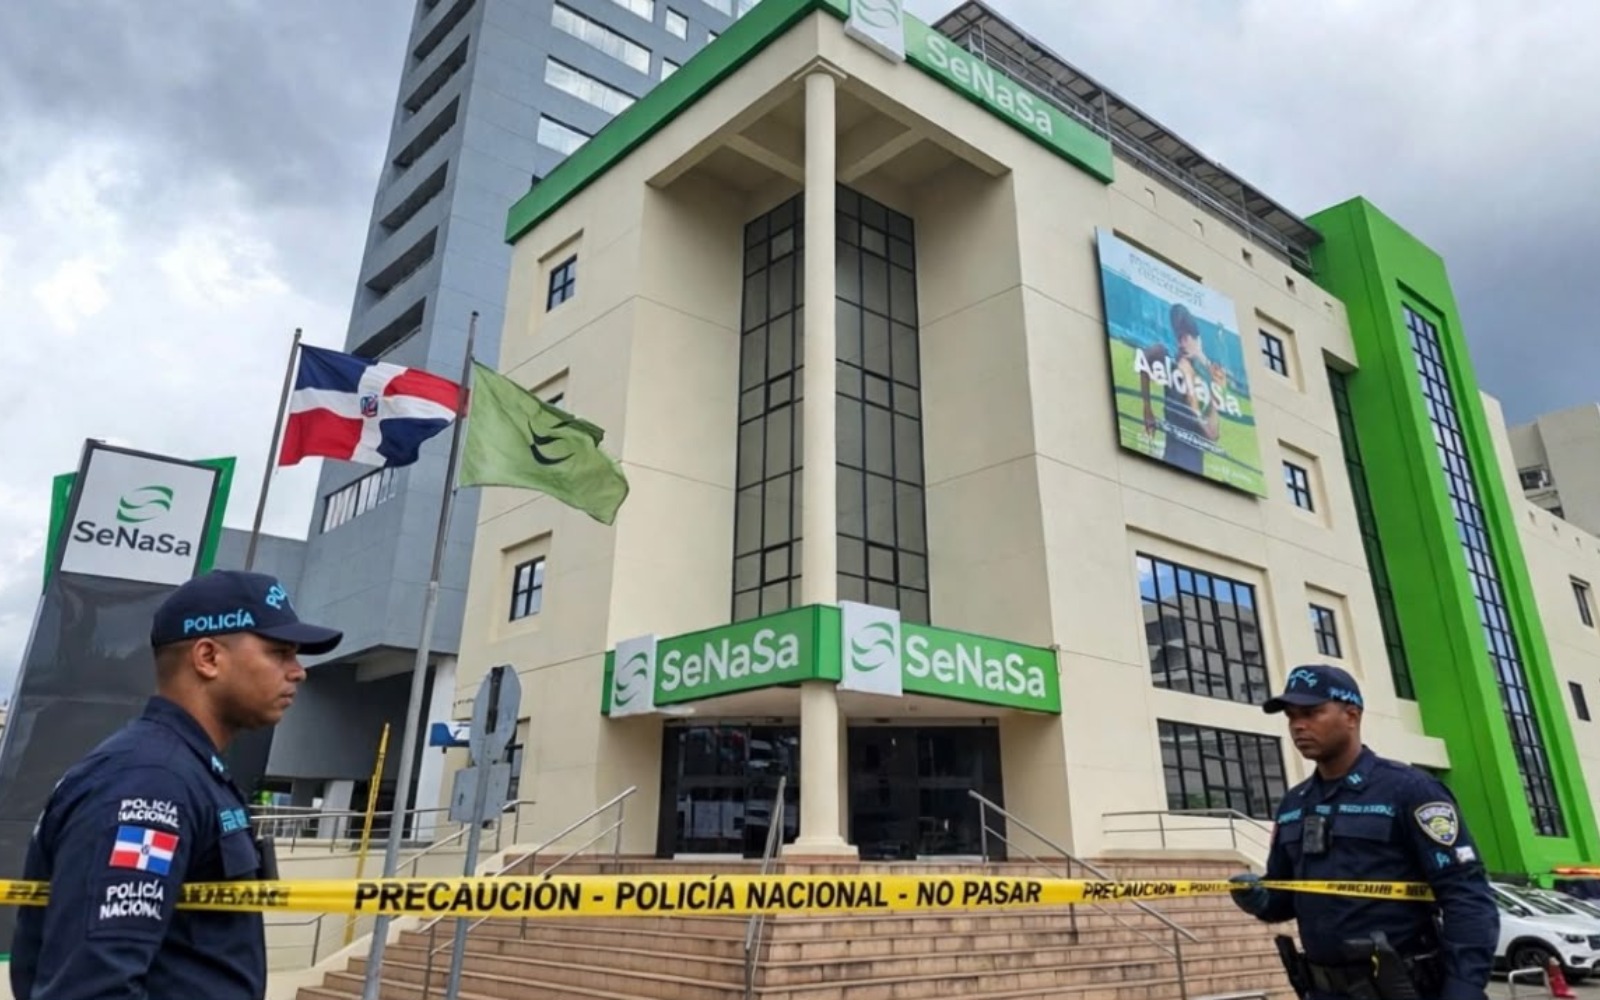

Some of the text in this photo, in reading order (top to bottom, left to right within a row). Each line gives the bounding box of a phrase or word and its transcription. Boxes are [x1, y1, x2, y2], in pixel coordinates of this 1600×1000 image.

[926, 34, 1054, 138] SeNaSa
[73, 520, 192, 557] SeNaSa
[184, 609, 255, 633] POLICÍA
[661, 628, 799, 692] SeNaSa
[906, 633, 1046, 698] SeNaSa
[354, 874, 582, 911] PRECAUCIÓN
[615, 874, 735, 910] POLICÍA
[746, 881, 888, 909] NACIONAL
[916, 880, 954, 906] NO
[962, 880, 1042, 905] PASAR
